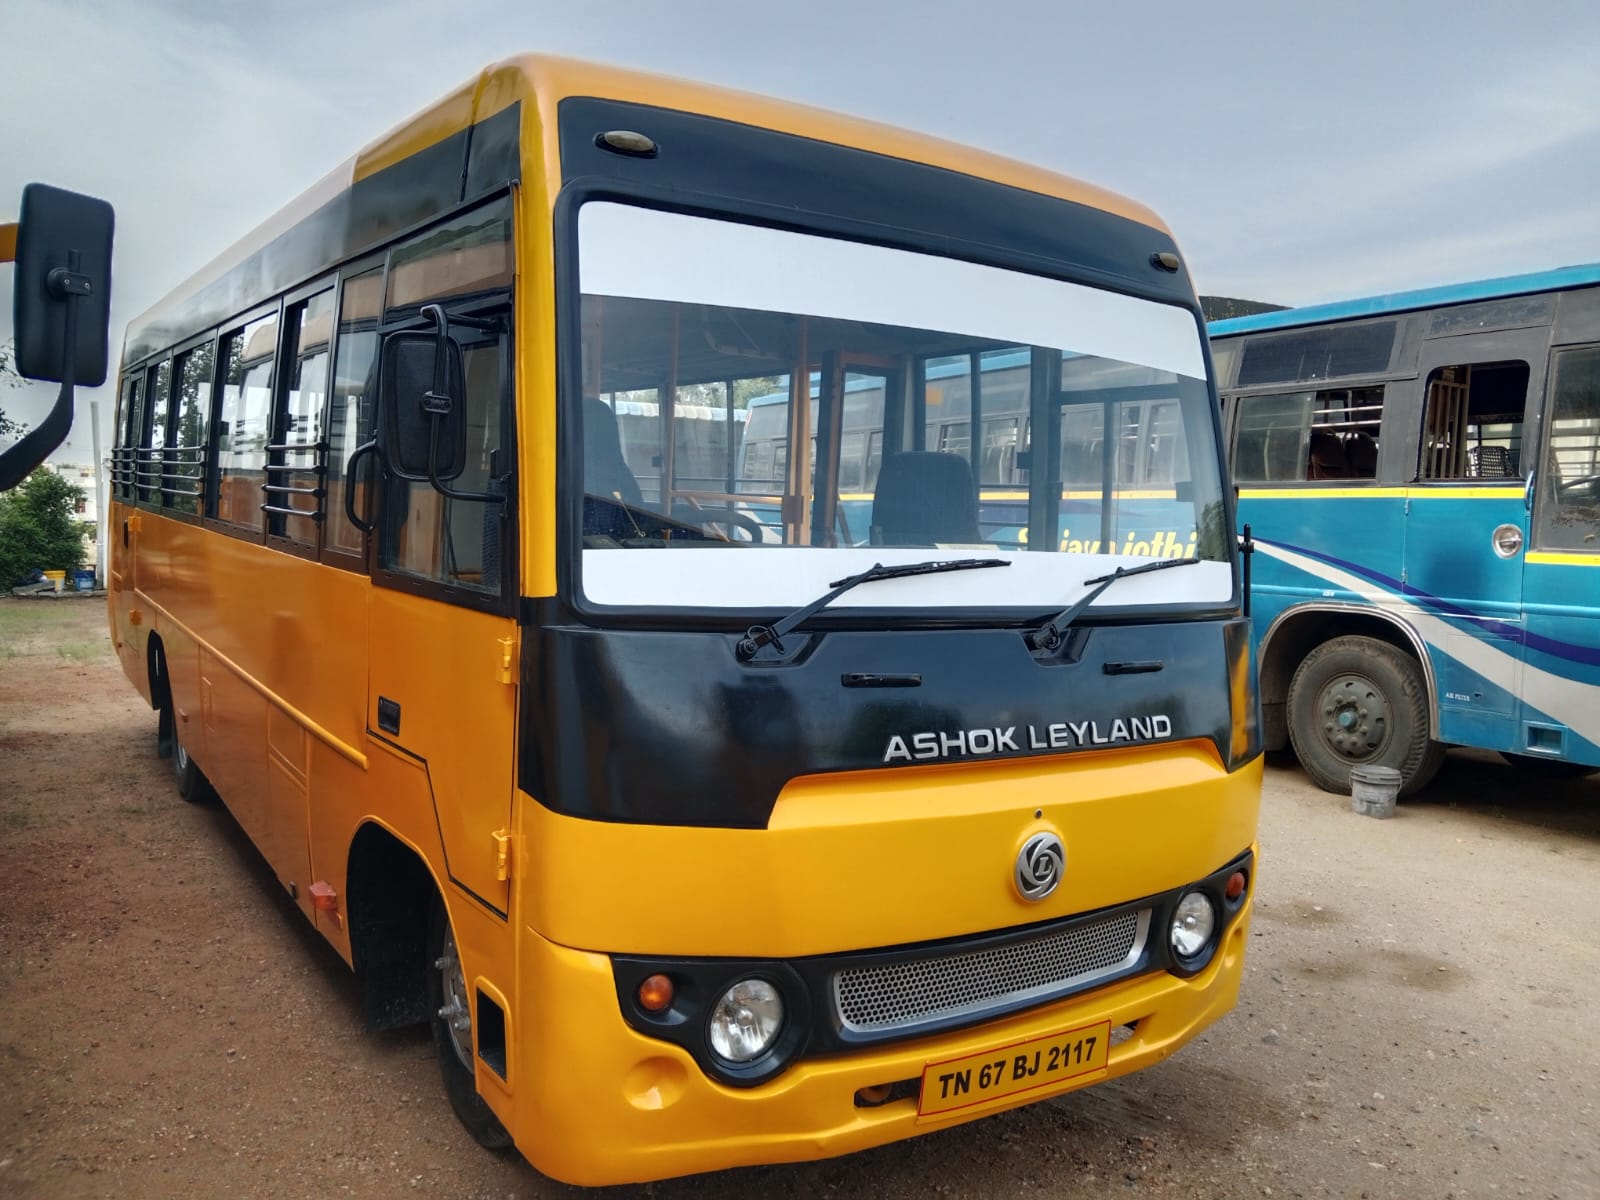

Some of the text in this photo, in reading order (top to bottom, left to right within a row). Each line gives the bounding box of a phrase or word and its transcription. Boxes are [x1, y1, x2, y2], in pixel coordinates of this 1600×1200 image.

[883, 714, 1172, 762] ASHOK LEYLAND
[938, 1037, 1097, 1099] TN 67 BJ 2117
